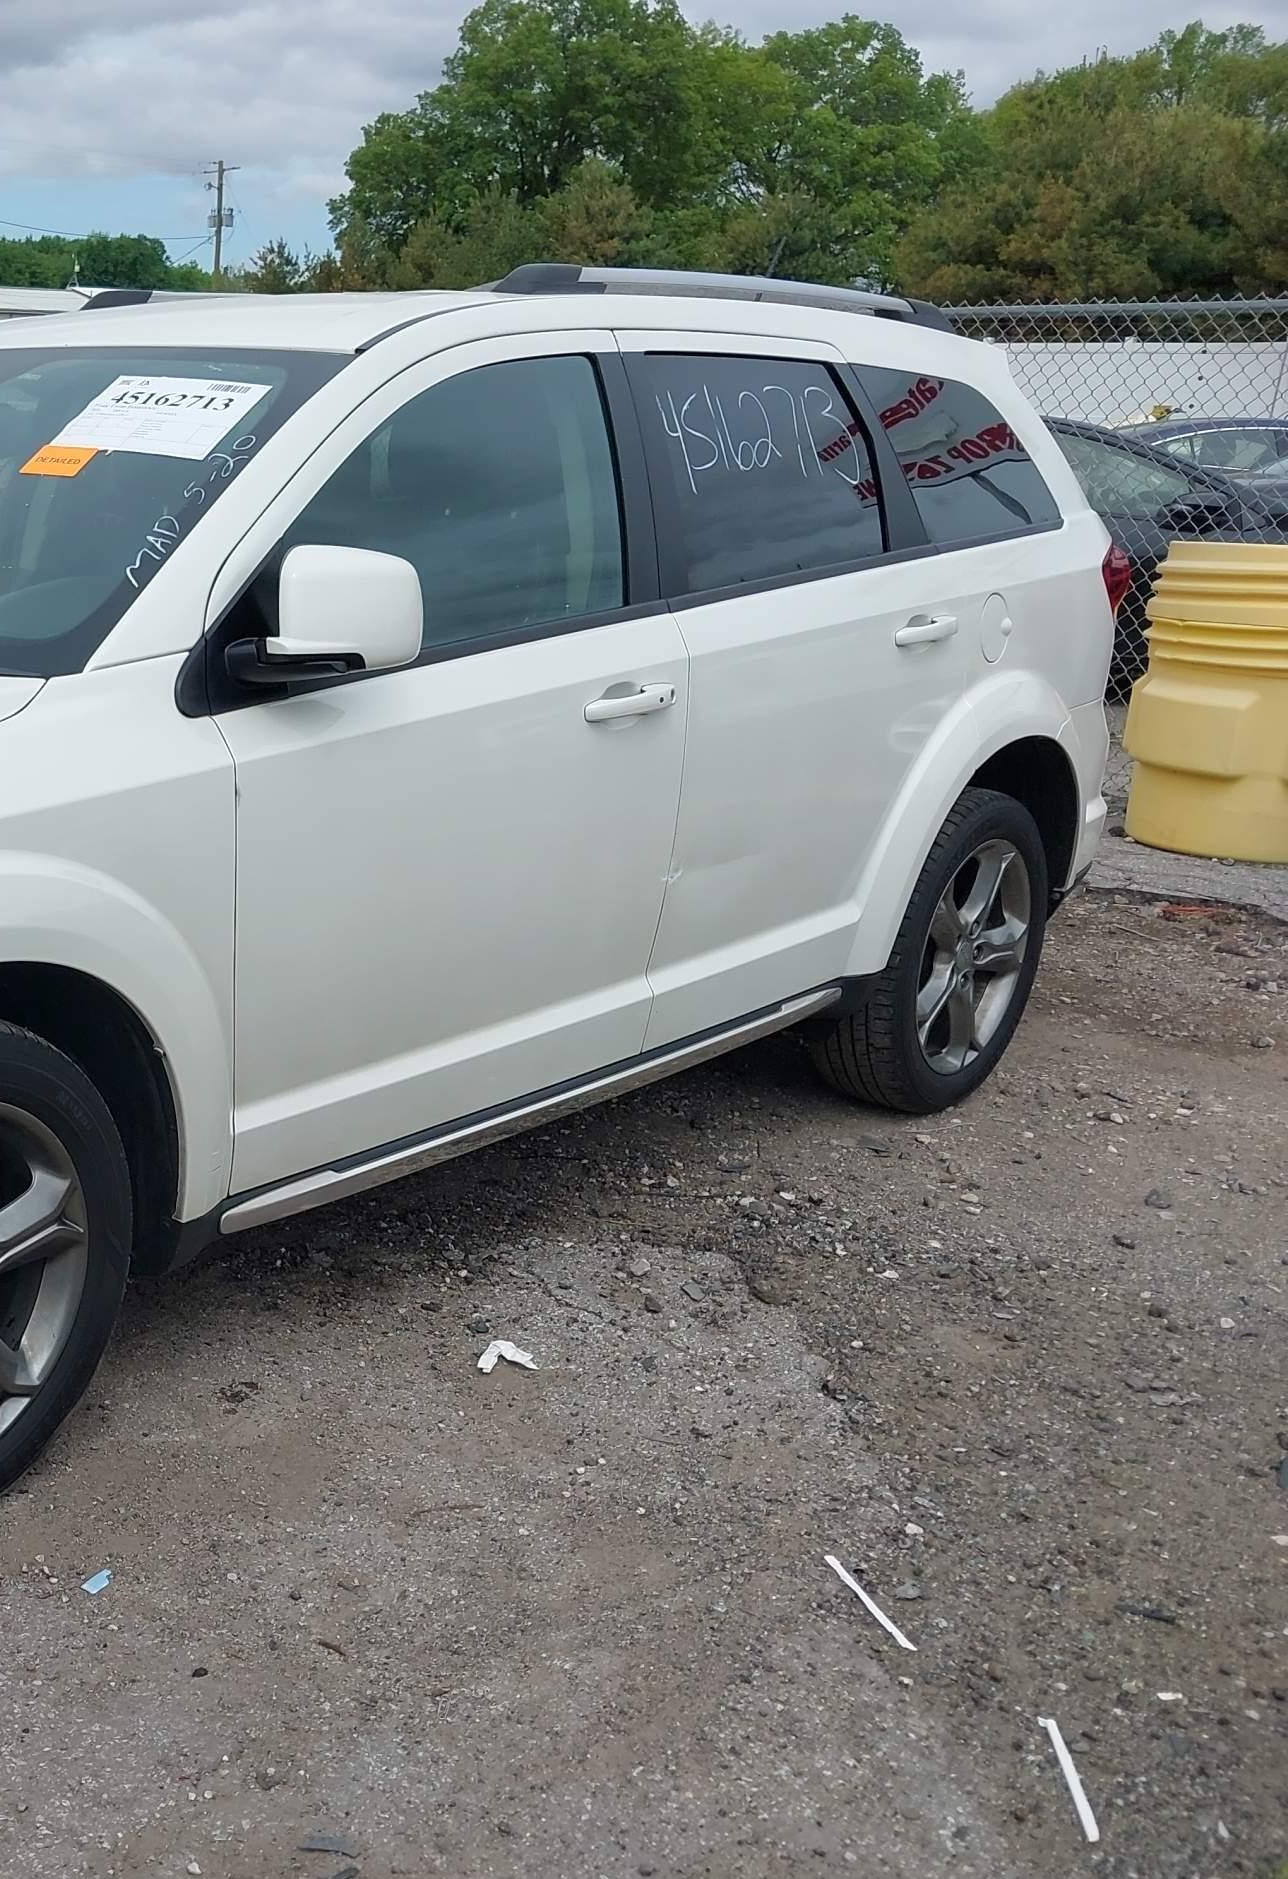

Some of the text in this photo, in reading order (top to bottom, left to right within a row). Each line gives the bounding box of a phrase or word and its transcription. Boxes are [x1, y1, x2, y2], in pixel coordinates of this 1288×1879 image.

[111, 390, 235, 412] 45162713
[655, 383, 861, 495] 45162713
[125, 515, 180, 588] MAD
